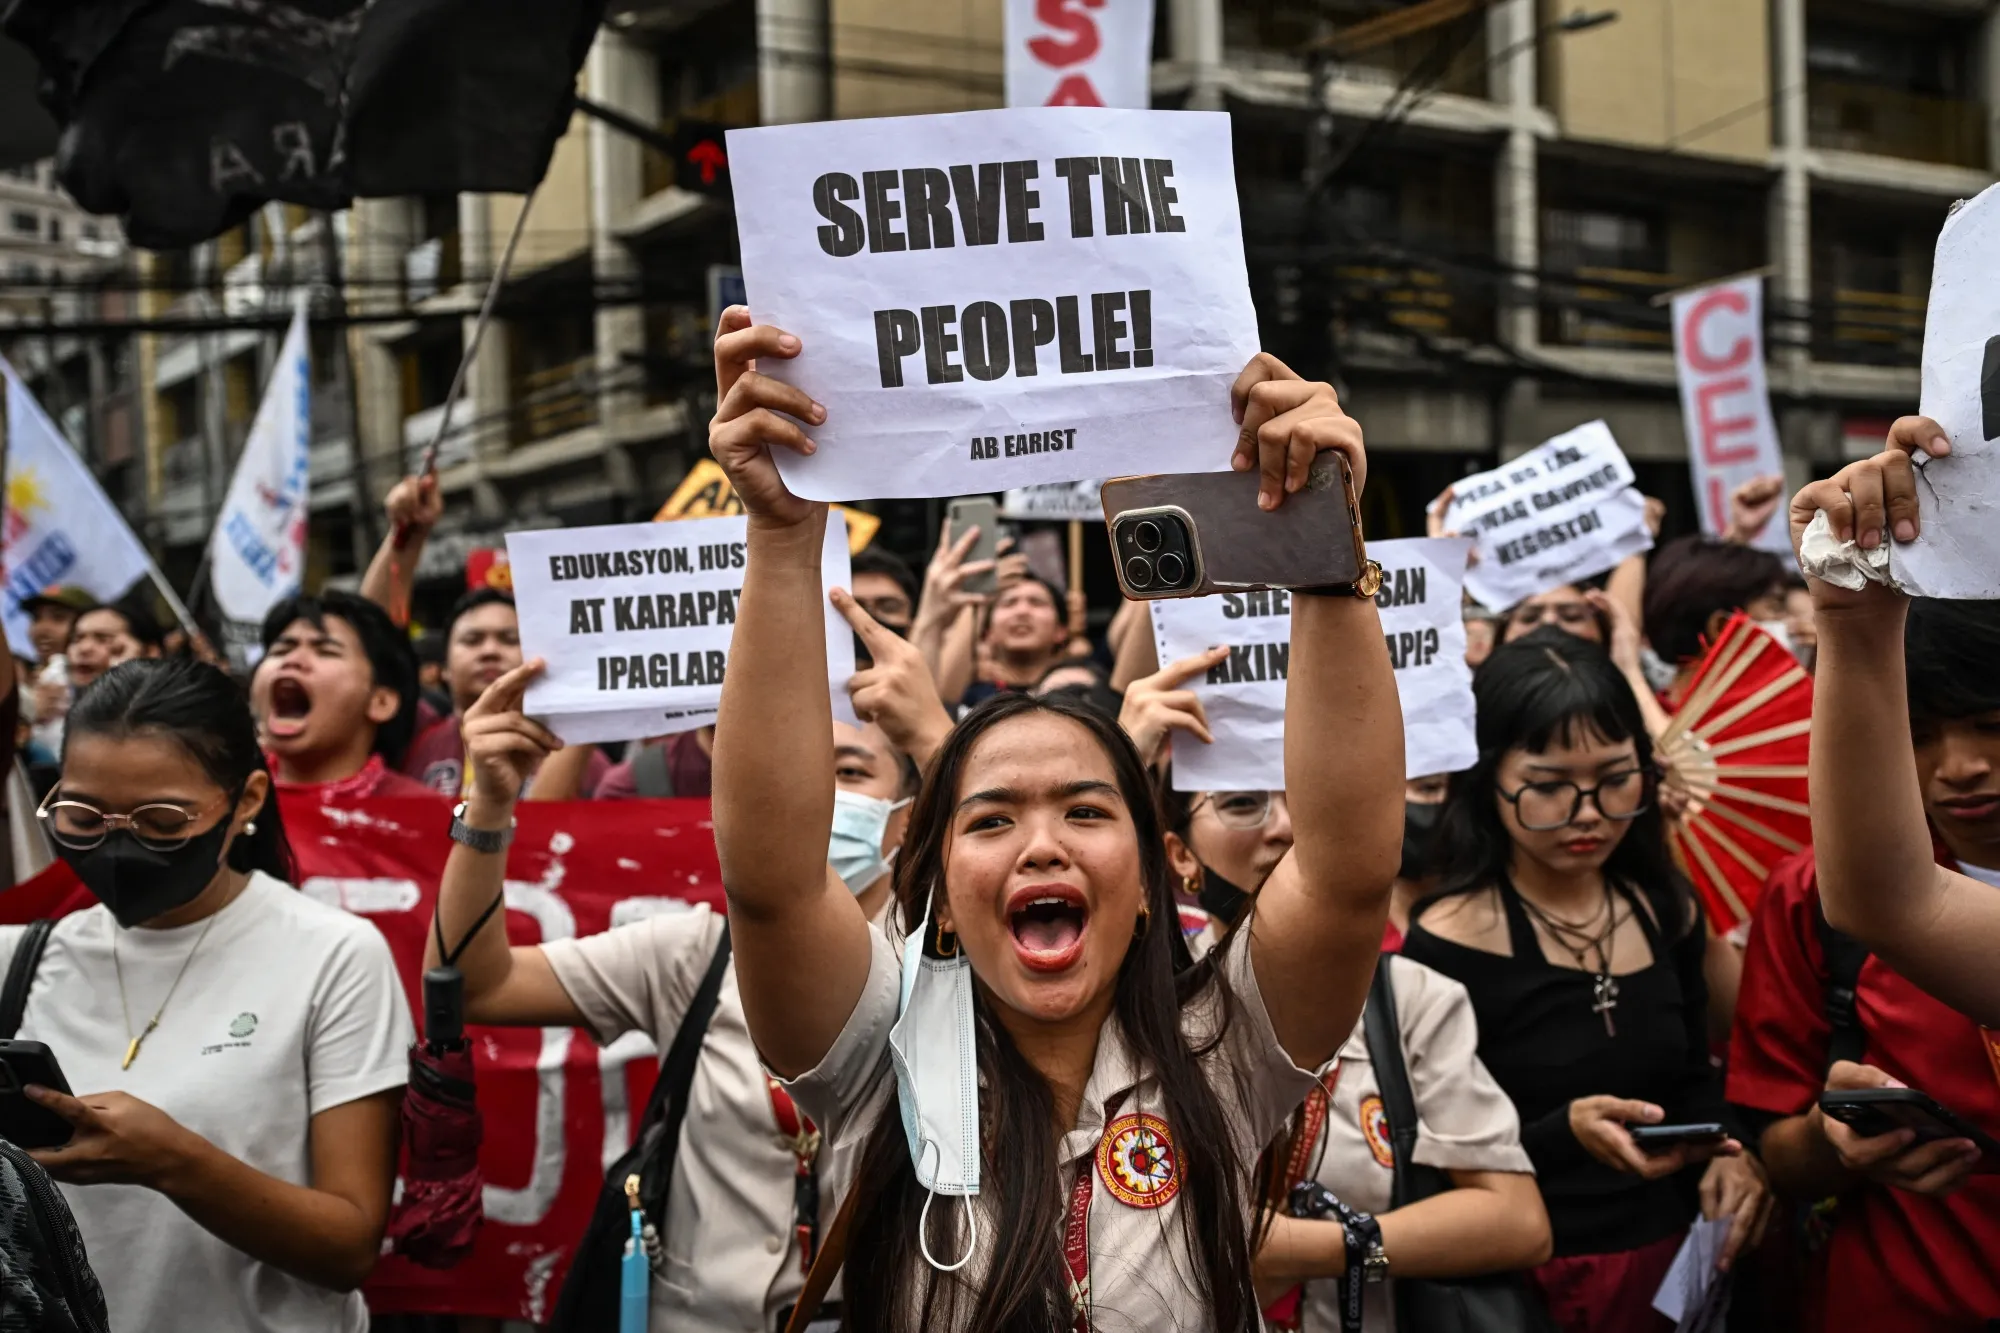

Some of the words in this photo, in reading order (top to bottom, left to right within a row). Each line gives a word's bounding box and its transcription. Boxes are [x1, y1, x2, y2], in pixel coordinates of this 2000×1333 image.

[812, 160, 1045, 257] SERVE
[1055, 156, 1186, 239] THE
[873, 290, 1154, 389] PEOPLE!
[970, 436, 999, 460] AB
[1004, 428, 1077, 458] EARIST
[549, 547, 694, 581] EDUKASYON,
[699, 542, 747, 571] HUS
[570, 598, 605, 634] AT
[1221, 590, 1290, 619] SHE
[1376, 567, 1427, 608] SAN
[597, 650, 726, 691] IPAGLAB
[1206, 642, 1290, 685] AKIN
[1386, 627, 1439, 670] API?
